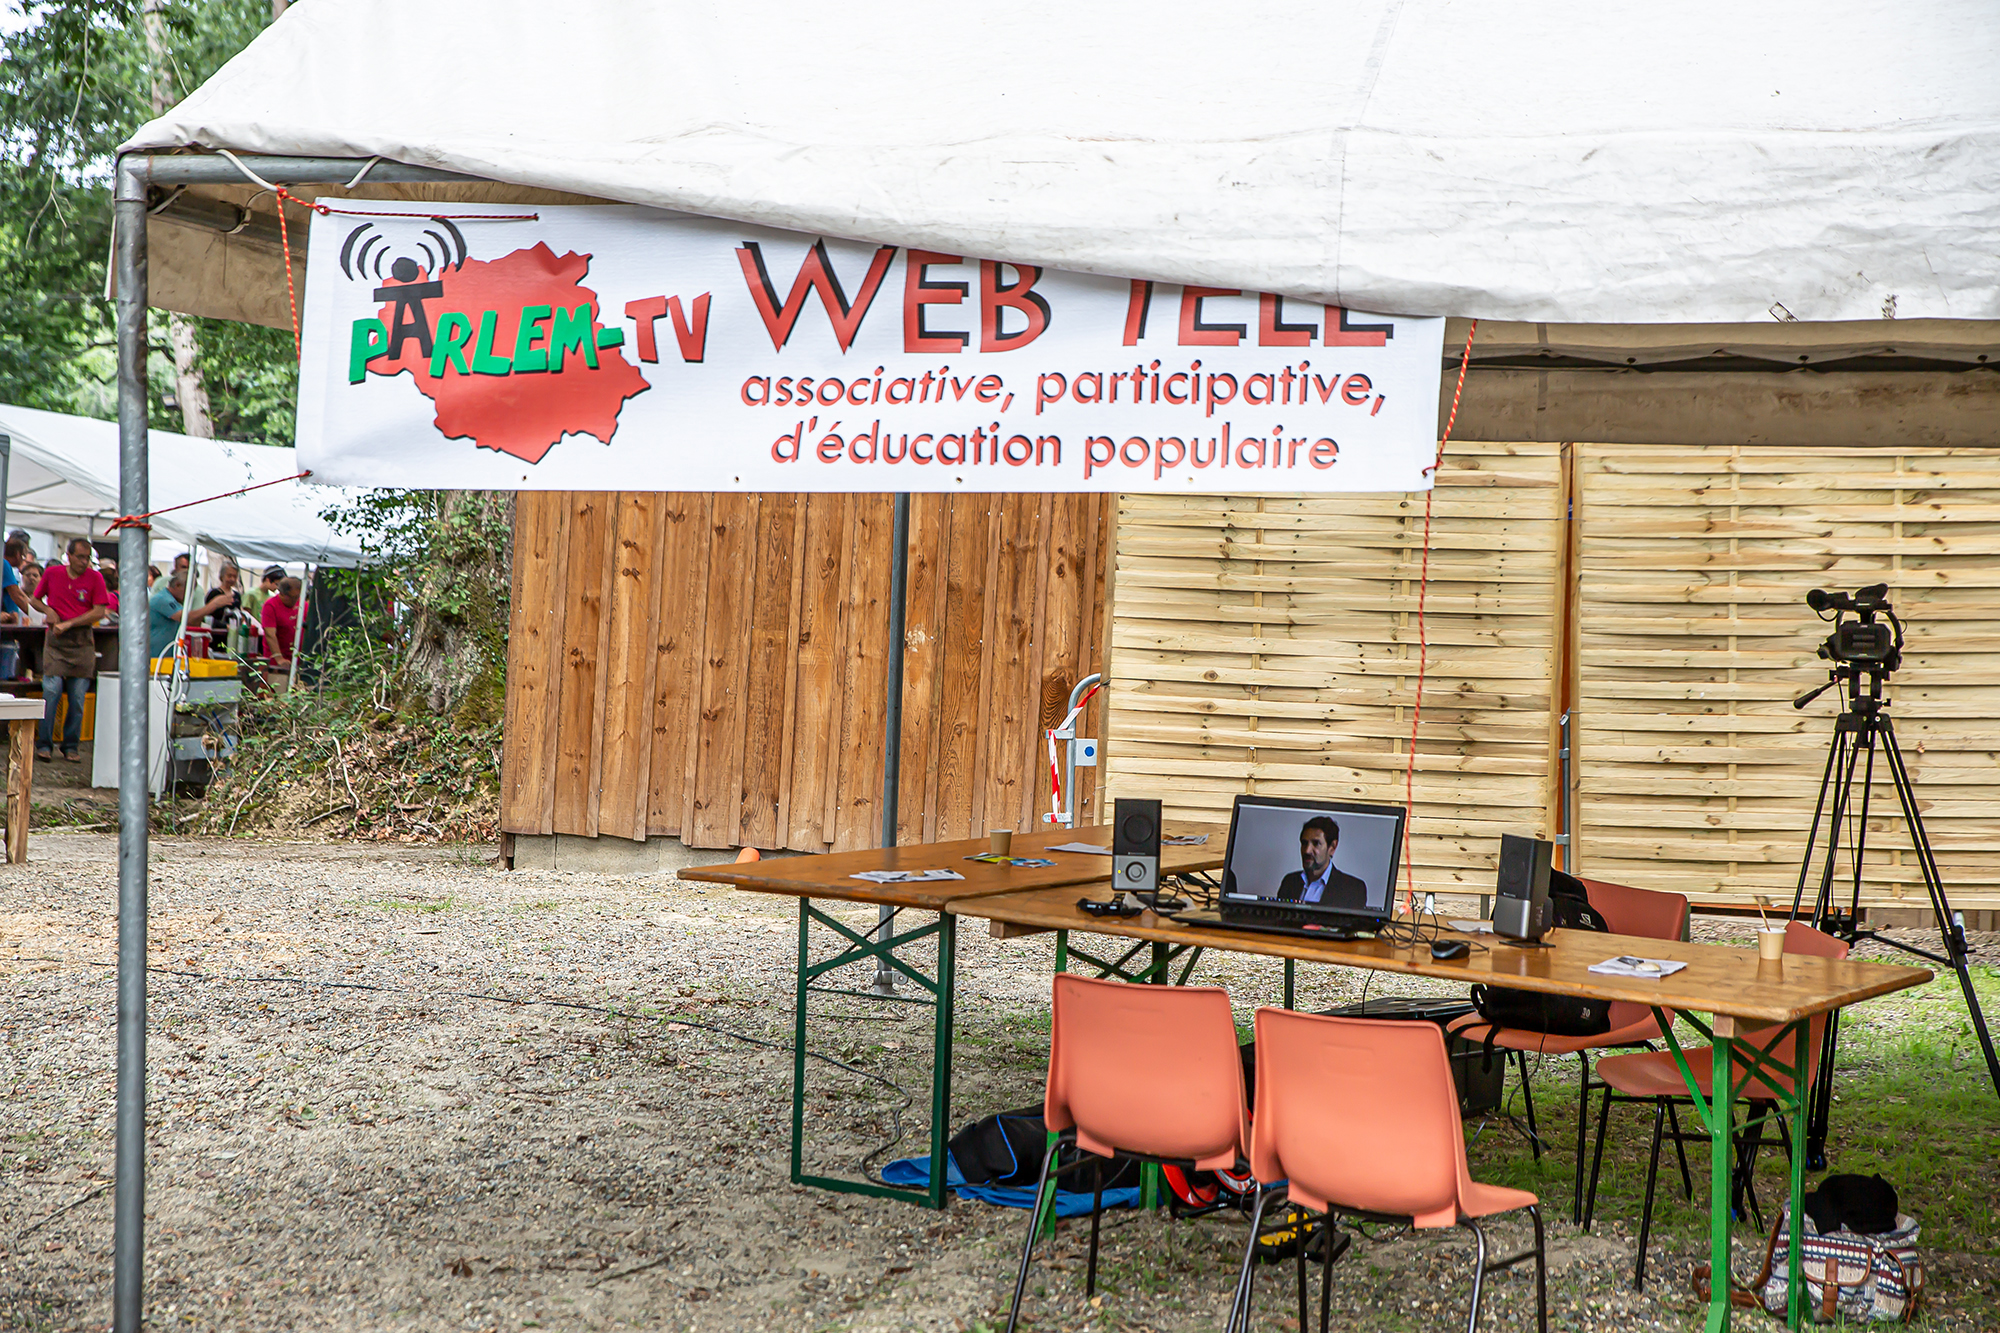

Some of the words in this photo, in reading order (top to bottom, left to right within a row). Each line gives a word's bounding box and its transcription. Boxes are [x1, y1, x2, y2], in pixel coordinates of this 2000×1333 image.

[735, 237, 1051, 354] WEB
[741, 366, 1014, 413] associative,
[1035, 359, 1385, 418] participative,
[771, 415, 1061, 467] d'éducation
[1083, 421, 1339, 480] populaire
